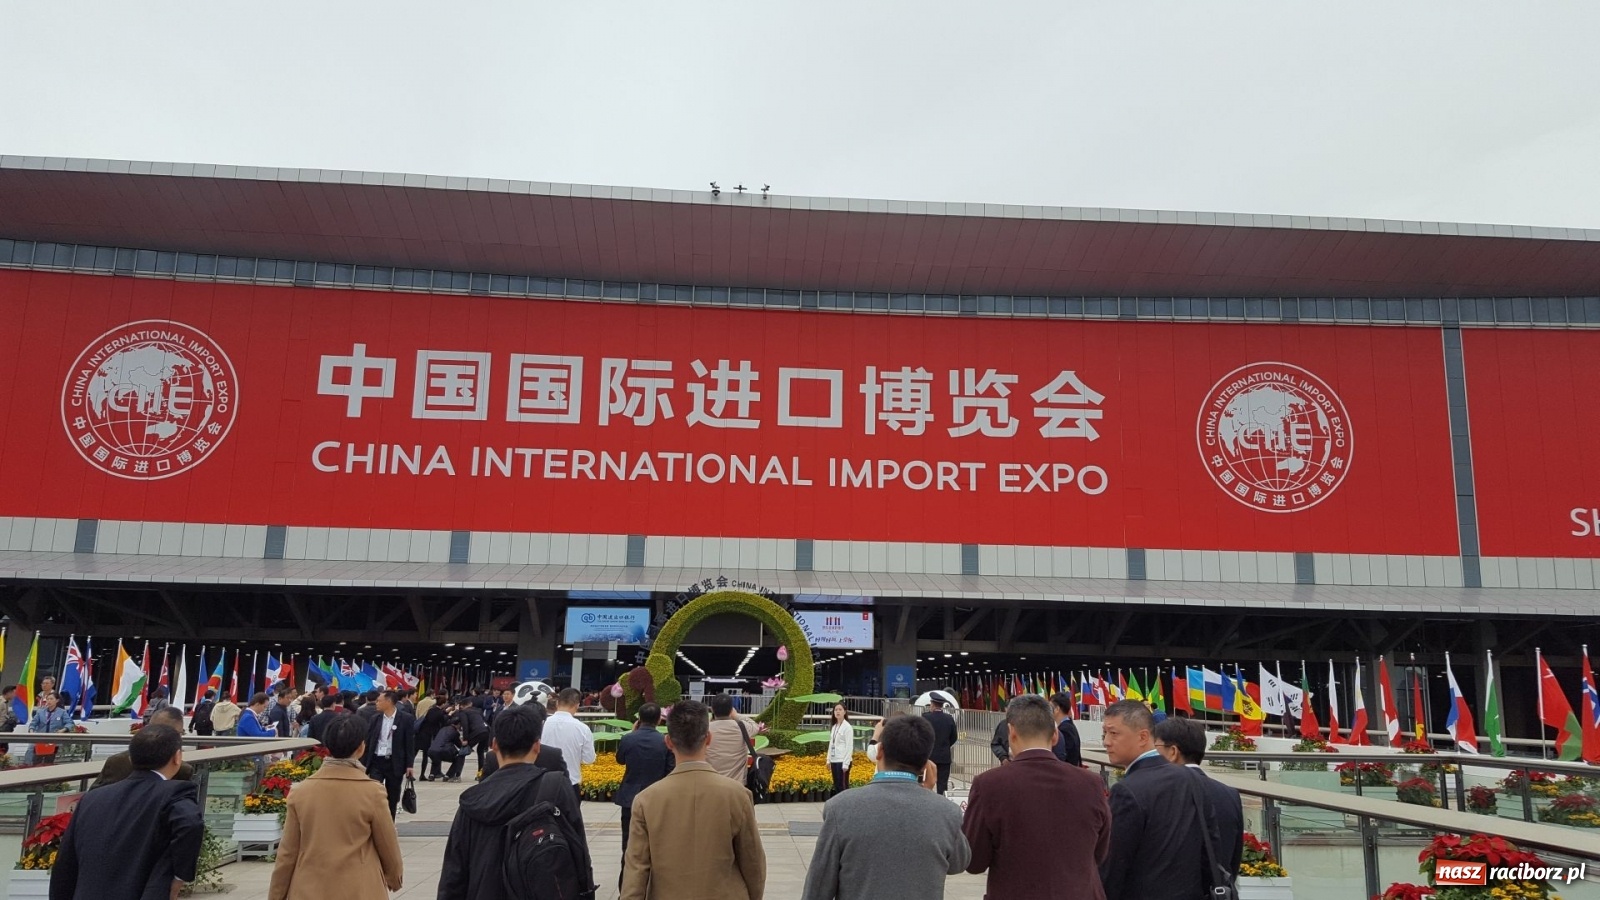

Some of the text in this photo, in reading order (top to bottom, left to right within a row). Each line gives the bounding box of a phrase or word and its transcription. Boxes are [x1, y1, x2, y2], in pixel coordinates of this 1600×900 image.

[72, 330, 228, 413] CHINA INTERNATIONAL IMPORT EXPO
[317, 343, 1105, 442] 中国国际进口博览会
[1206, 371, 1345, 448] CHINA INTERNATIONAL IMPORT EXPO
[72, 416, 222, 474] 中国国际进口博览会
[311, 440, 1108, 495] CHINA INTERNATIONAL IMPORT EXPO
[1211, 454, 1343, 507] 中国国际进口博览会
[731, 579, 757, 590] CHINA
